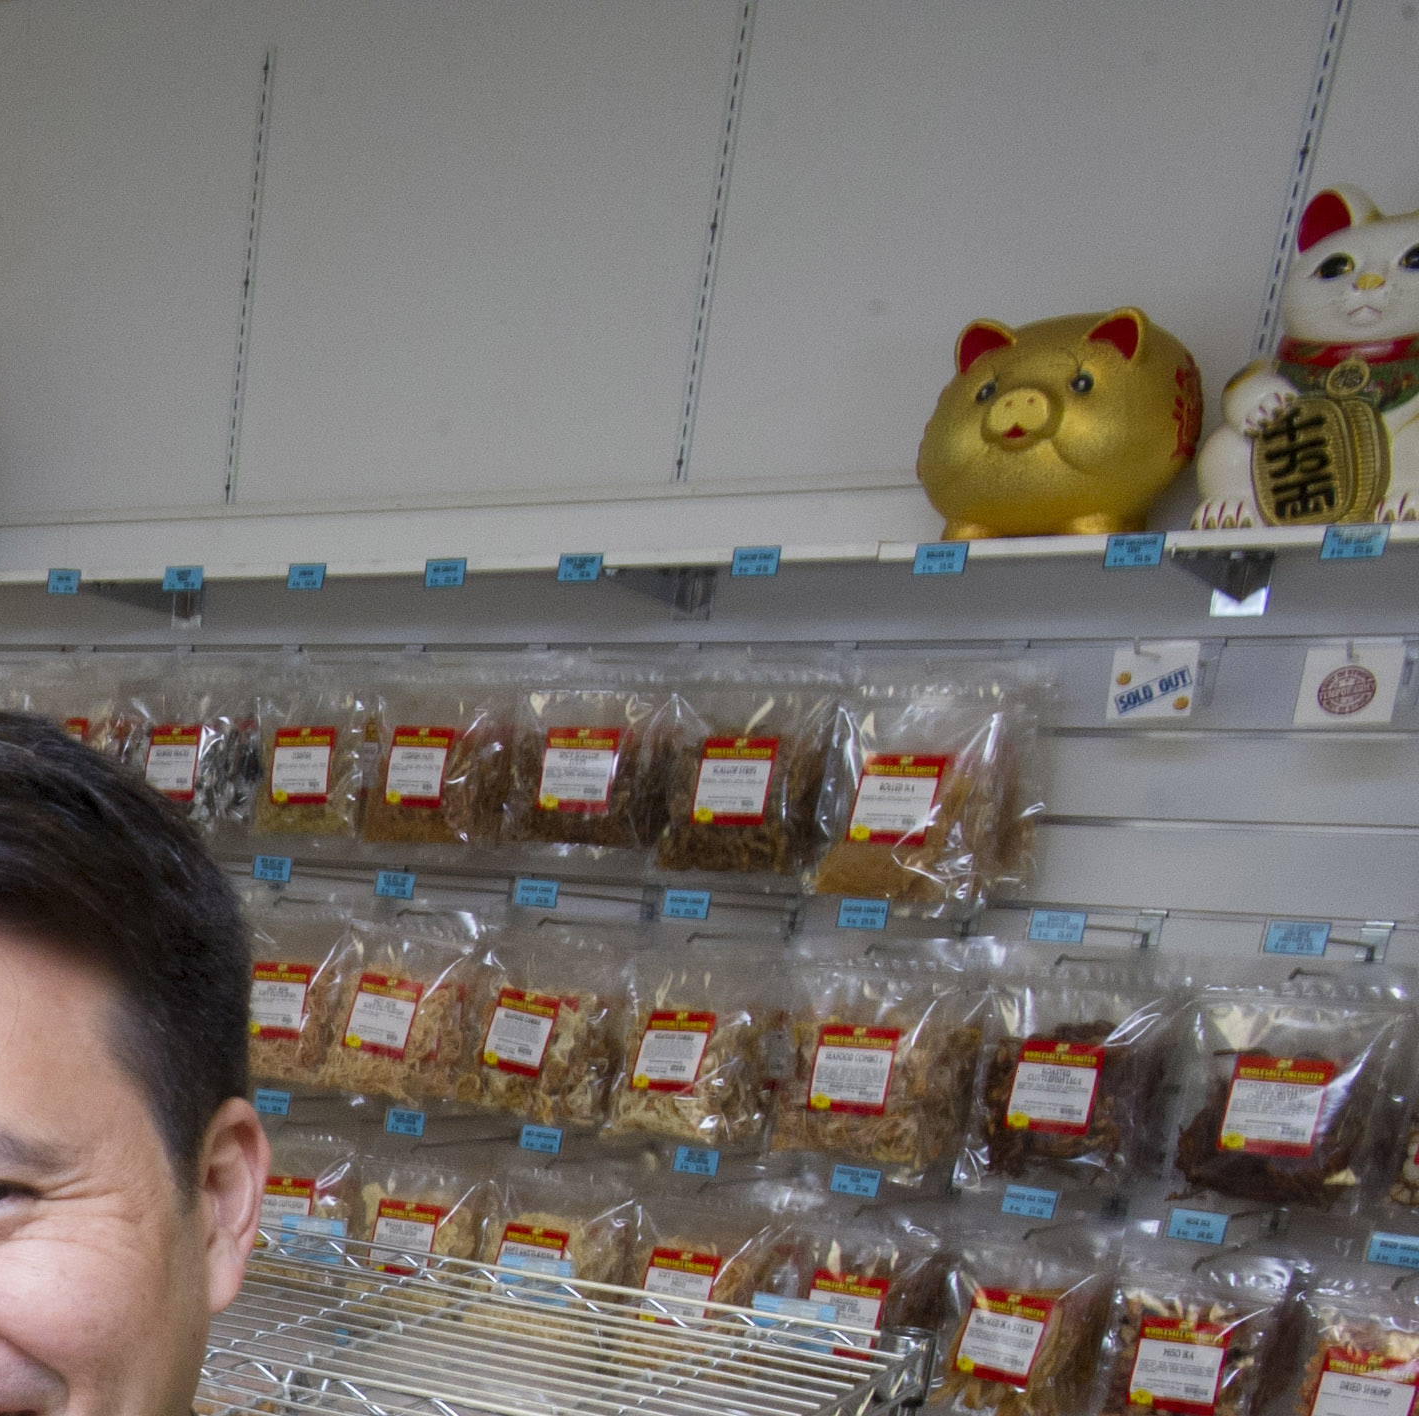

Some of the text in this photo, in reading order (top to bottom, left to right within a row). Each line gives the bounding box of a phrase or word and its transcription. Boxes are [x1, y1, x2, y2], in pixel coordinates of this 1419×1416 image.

[1118, 669, 1189, 710] SOLD OUT
[1163, 1347, 1195, 1361] MISO IKA
[1339, 1380, 1392, 1397] DRIED SHRIMP
